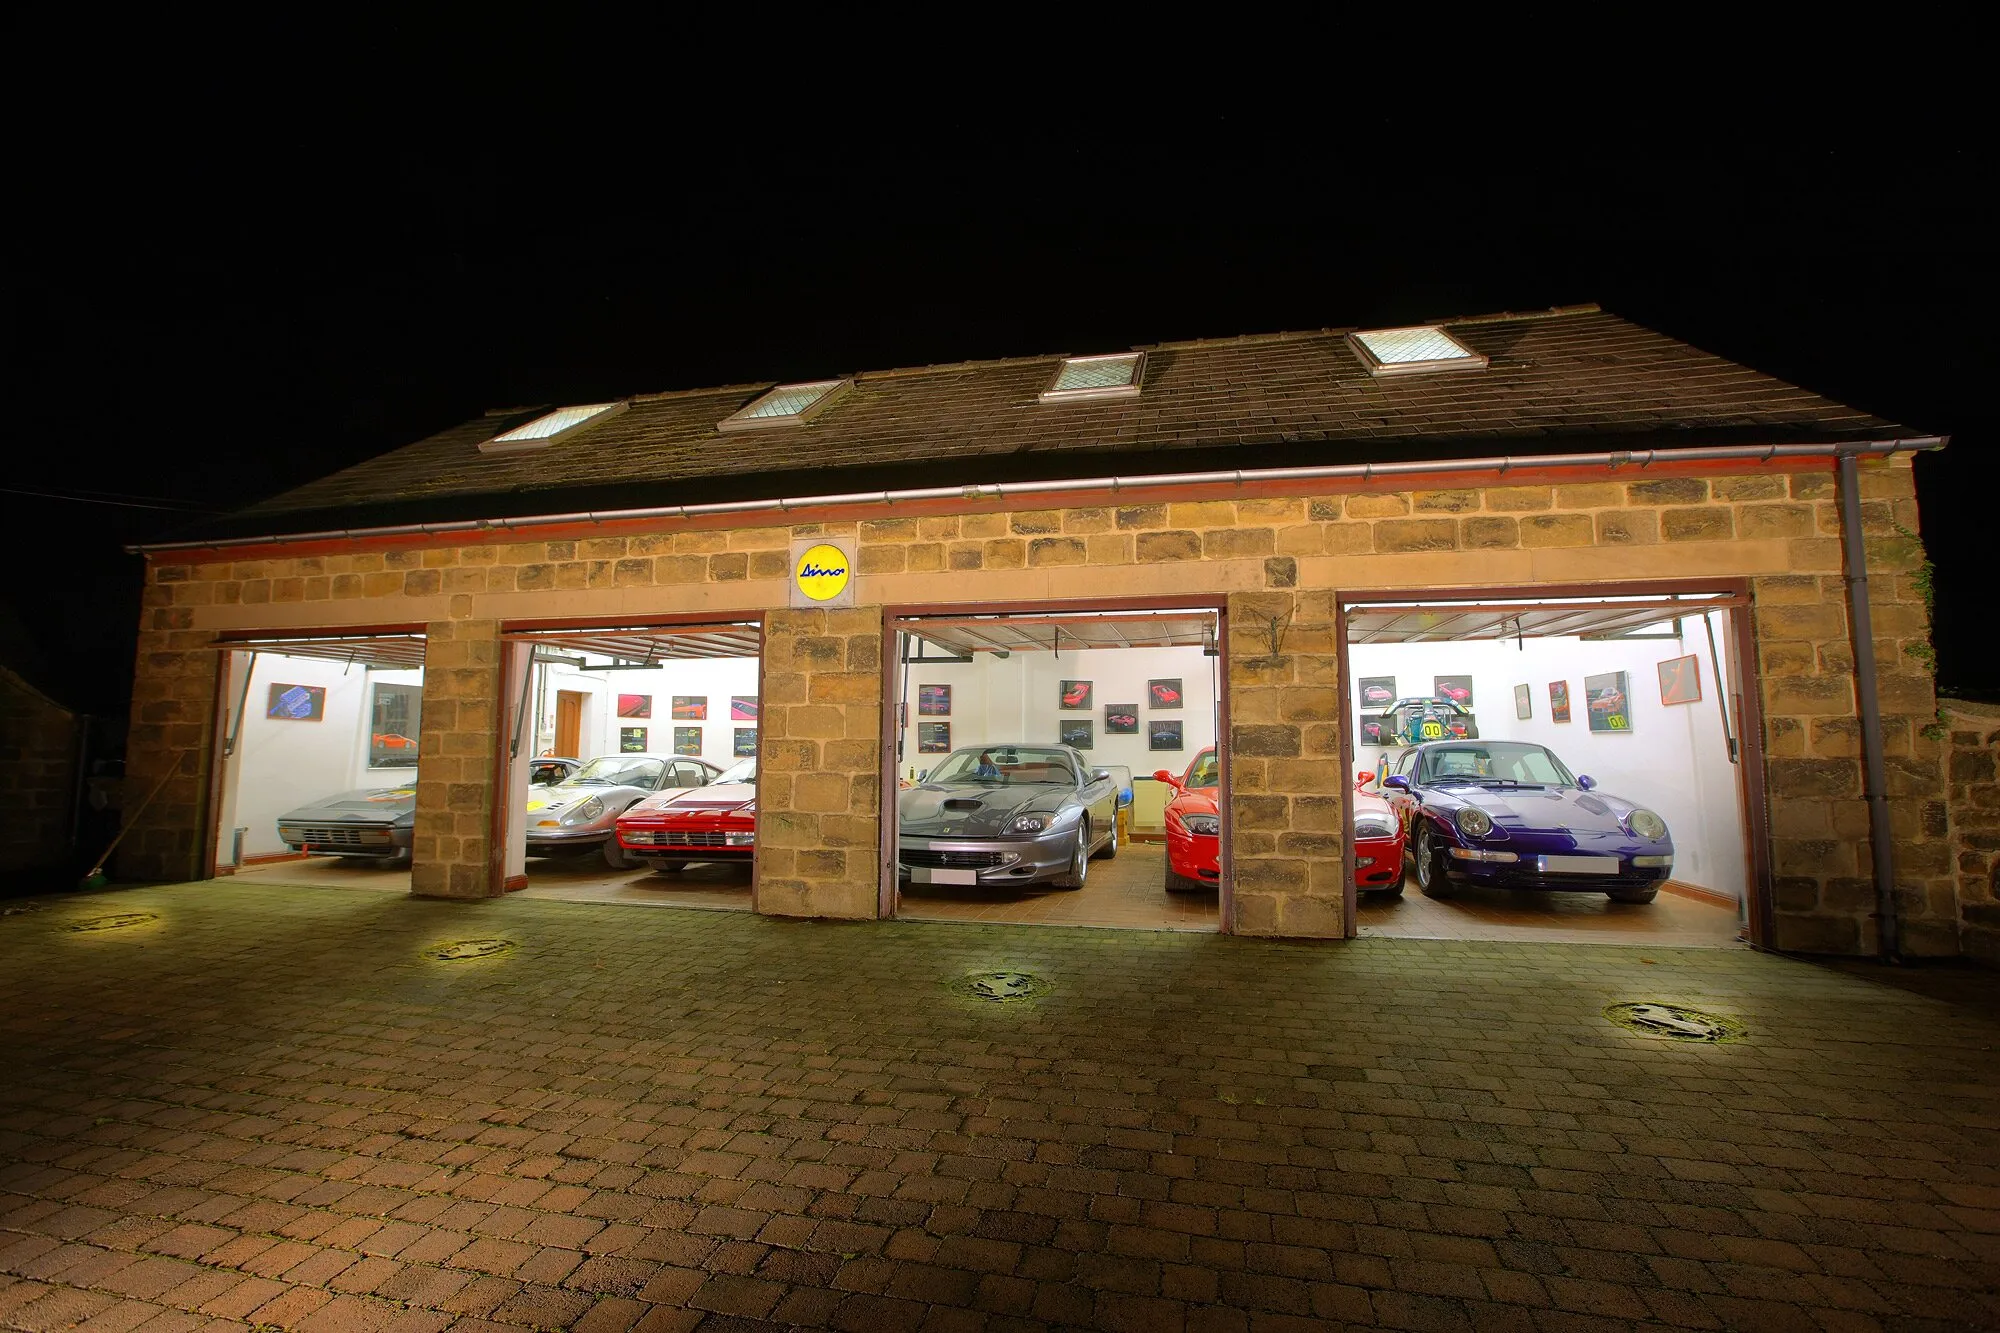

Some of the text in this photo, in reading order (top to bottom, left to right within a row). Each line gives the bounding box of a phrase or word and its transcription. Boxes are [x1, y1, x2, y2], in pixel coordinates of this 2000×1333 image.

[800, 563, 845, 577] Dino
[1609, 716, 1626, 728] 00
[1424, 725, 1440, 736] 00
